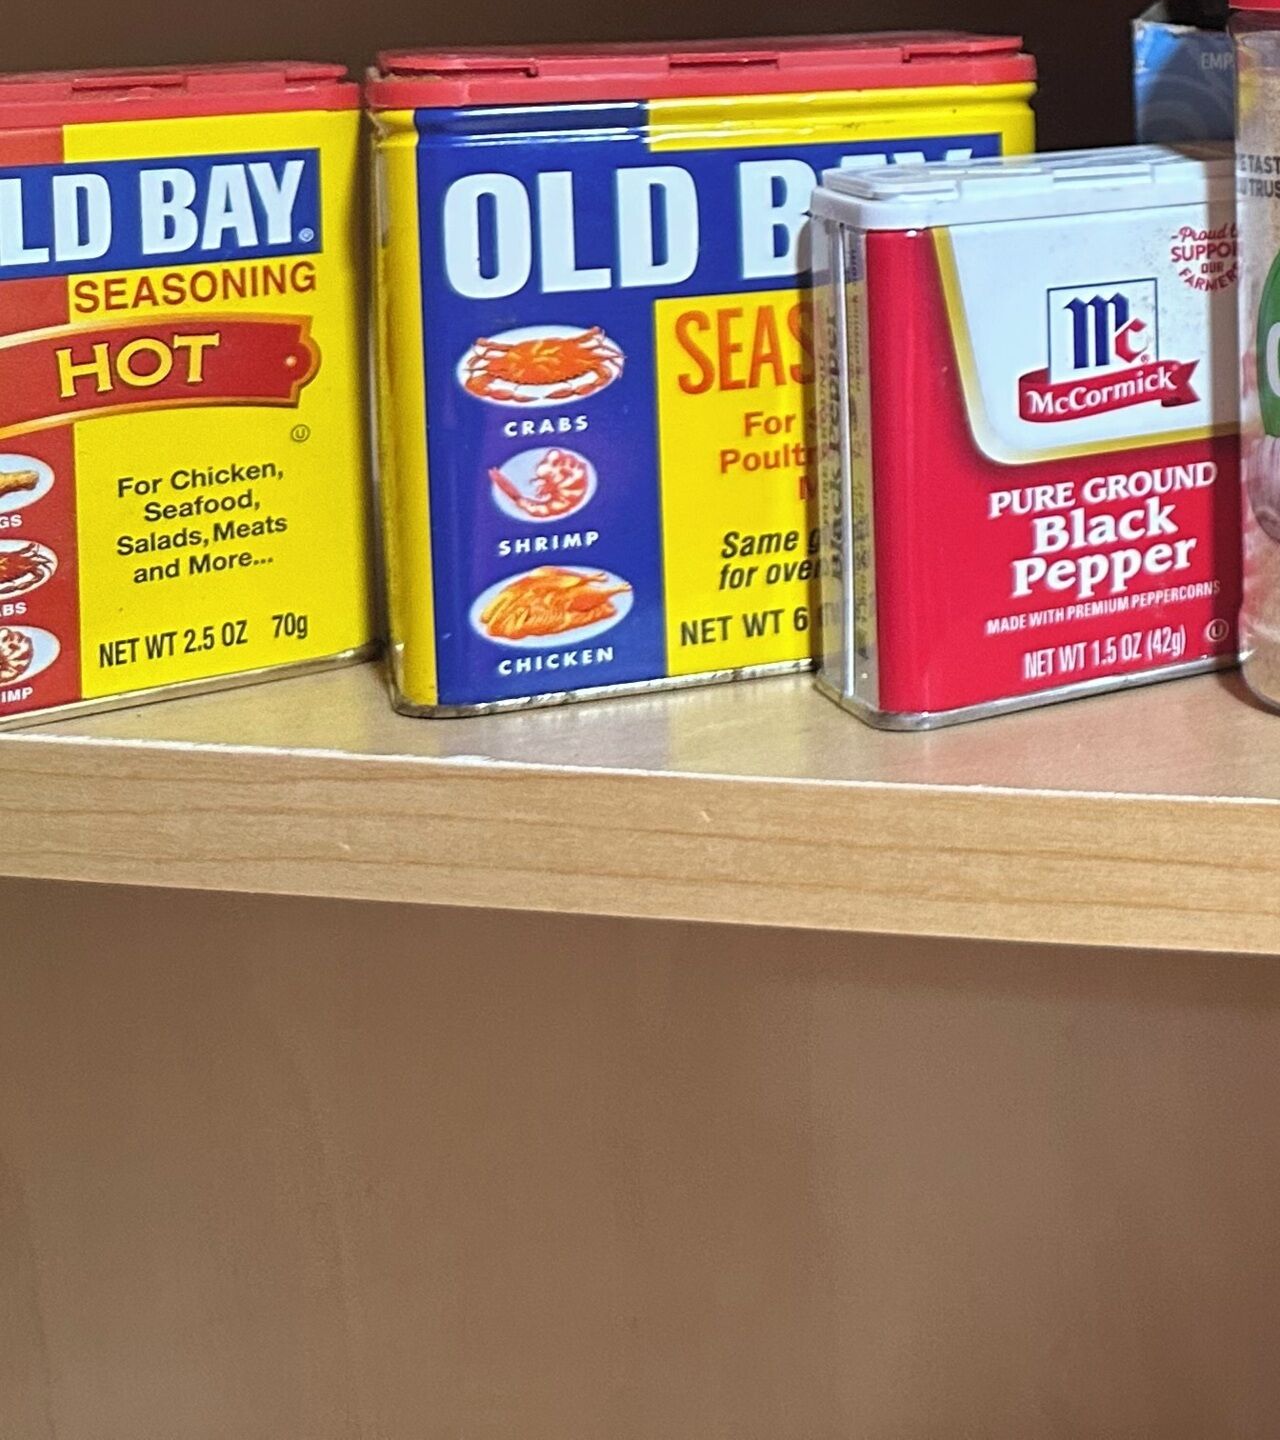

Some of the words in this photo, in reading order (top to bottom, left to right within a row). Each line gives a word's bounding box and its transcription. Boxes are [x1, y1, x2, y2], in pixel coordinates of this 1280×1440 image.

[443, 165, 699, 300] OLD
[74, 262, 317, 313] SEASONING
[57, 332, 221, 398] HOT
[1027, 366, 1177, 417] McCormick
[504, 415, 589, 436] CRABS
[745, 411, 796, 437] For
[117, 474, 163, 498] For
[170, 460, 285, 494] Chicken,
[990, 485, 1075, 519] PURE
[1083, 462, 1218, 503] GROUND
[144, 489, 261, 523] Seafood,
[1033, 498, 1179, 553] Black
[116, 525, 210, 558] Salads,
[212, 513, 288, 545] Meats
[498, 531, 600, 557] SHRIMP
[722, 530, 799, 558] Same
[133, 558, 181, 584] and
[189, 550, 274, 575] More...
[719, 564, 758, 590] for
[1012, 534, 1196, 599] Pepper
[0, 600, 27, 617] BS
[681, 615, 732, 646] NET
[743, 609, 784, 640] WT
[793, 606, 809, 632] 6
[986, 617, 1027, 636] MADE
[1029, 611, 1065, 628] WITH
[1067, 597, 1130, 623] PREMIUM
[1131, 580, 1221, 609] PEPPERCORNS
[99, 632, 139, 668] NET
[144, 628, 178, 661] WT
[183, 624, 219, 657] 2.5
[221, 619, 249, 648] OZ
[272, 611, 308, 643] 70g
[498, 647, 614, 674] CHICKEN
[1024, 647, 1056, 679] NET
[1059, 641, 1088, 672] WT
[1092, 636, 1118, 667] 1.5
[1121, 631, 1143, 659] OZ
[1147, 625, 1187, 660] (42g)
